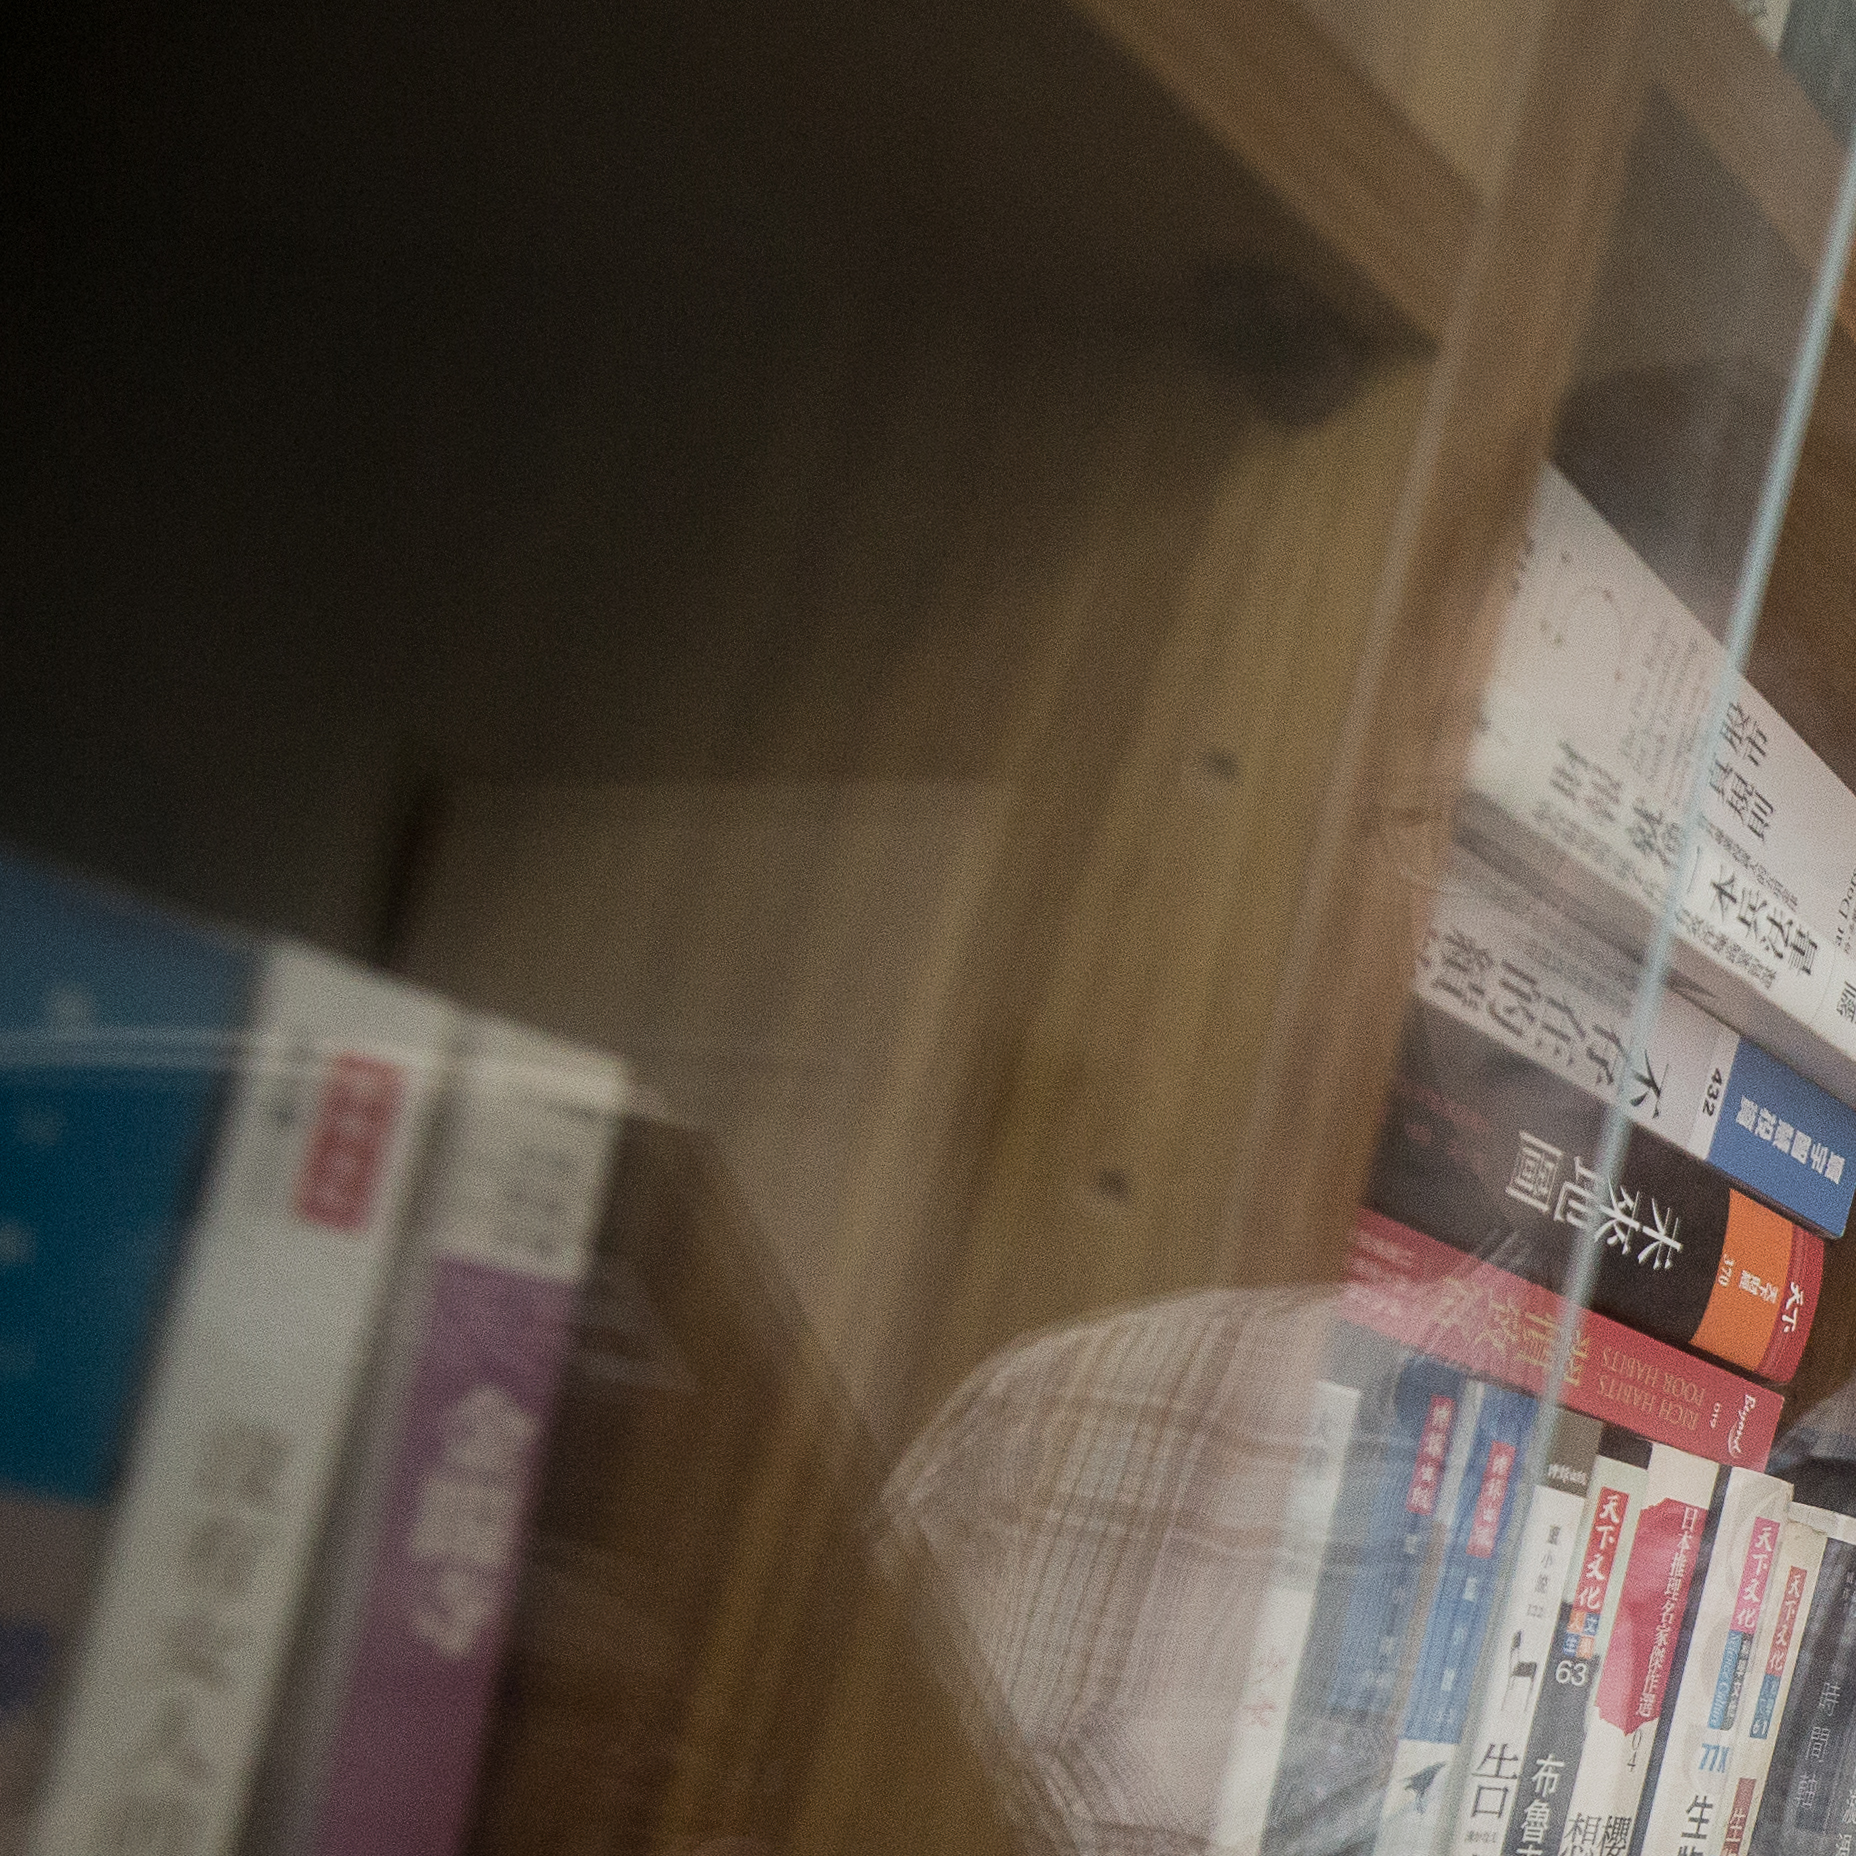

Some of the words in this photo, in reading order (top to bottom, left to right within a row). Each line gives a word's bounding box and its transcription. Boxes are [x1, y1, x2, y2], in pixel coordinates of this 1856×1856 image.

[1716, 696, 1773, 773] 股市
[1703, 751, 1777, 845] 真規則
[1699, 1066, 1726, 1119] 432
[1731, 1094, 1851, 1187] 寰宇智慧投資
[1499, 1126, 1691, 1280] 未來地圖
[1714, 1252, 1736, 1287] 370
[1776, 1280, 1808, 1337] 天下
[1593, 1370, 1658, 1415] HABITS
[1598, 1345, 1663, 1389] HABITS
[1662, 1371, 1707, 1408] POOR
[1657, 1397, 1700, 1432] RICH
[1576, 1493, 1625, 1611] 天下文化
[1733, 1525, 1779, 1631] 天下文化
[1634, 1505, 1700, 1718] 日本推理名家傑作選
[1767, 1571, 1807, 1672] 天下文化
[1553, 1658, 1590, 1689] 63
